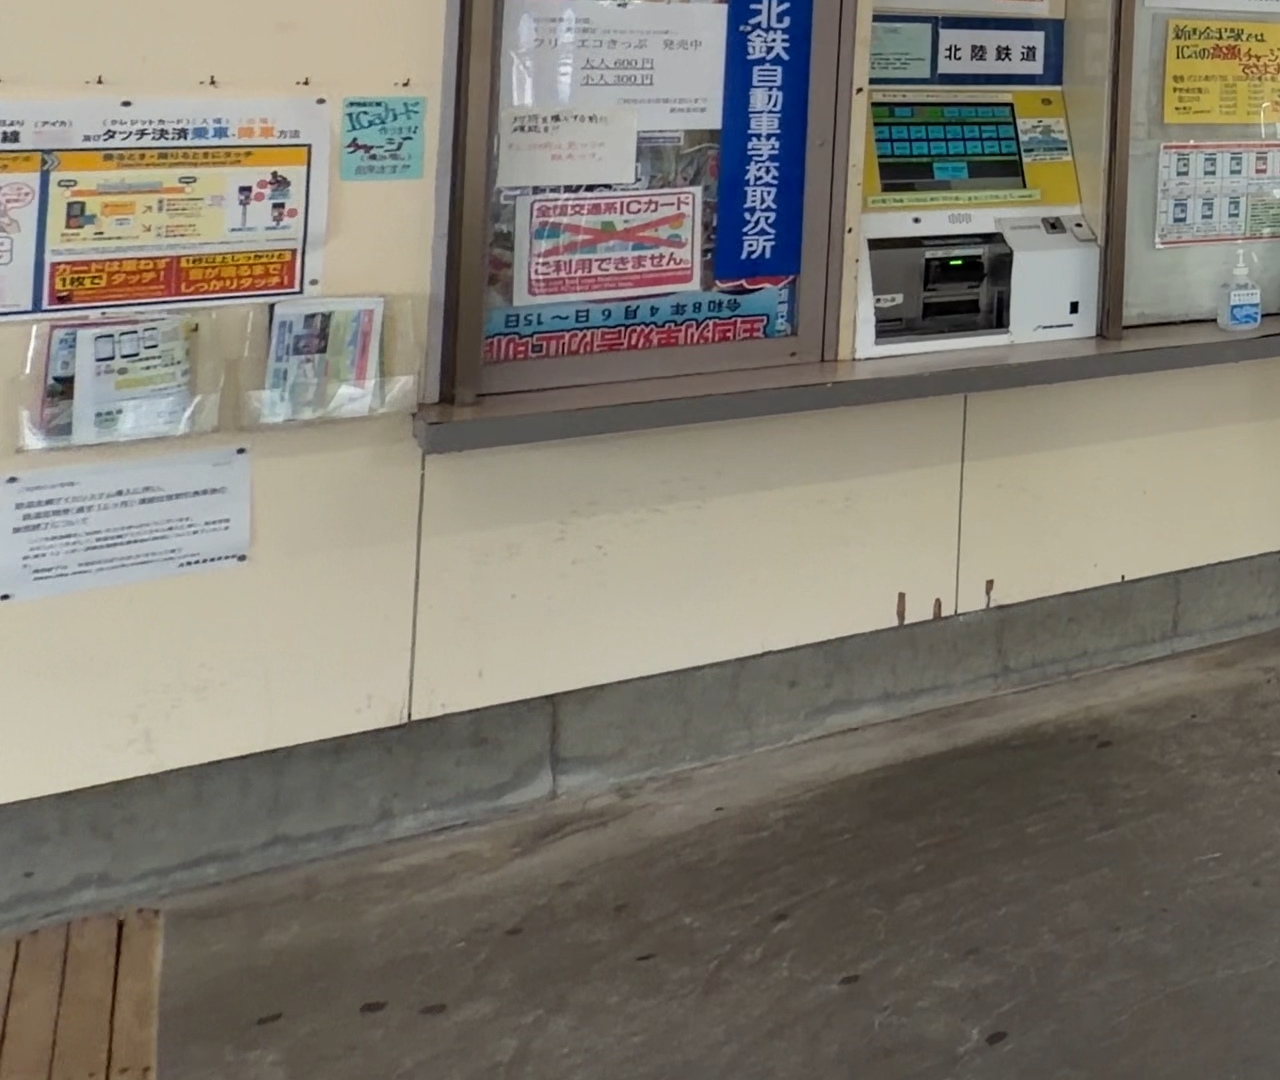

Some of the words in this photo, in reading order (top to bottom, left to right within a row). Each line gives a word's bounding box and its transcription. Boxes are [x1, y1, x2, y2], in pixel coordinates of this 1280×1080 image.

[663, 38, 702, 51] 発売中
[944, 43, 1038, 63] 北陸鉄道
[614, 58, 653, 70] 600円
[614, 73, 653, 86] 300円
[535, 196, 690, 219] 全国交通系ICカード
[535, 252, 690, 276] ご利用できません。
[58, 274, 104, 288] 1枚で
